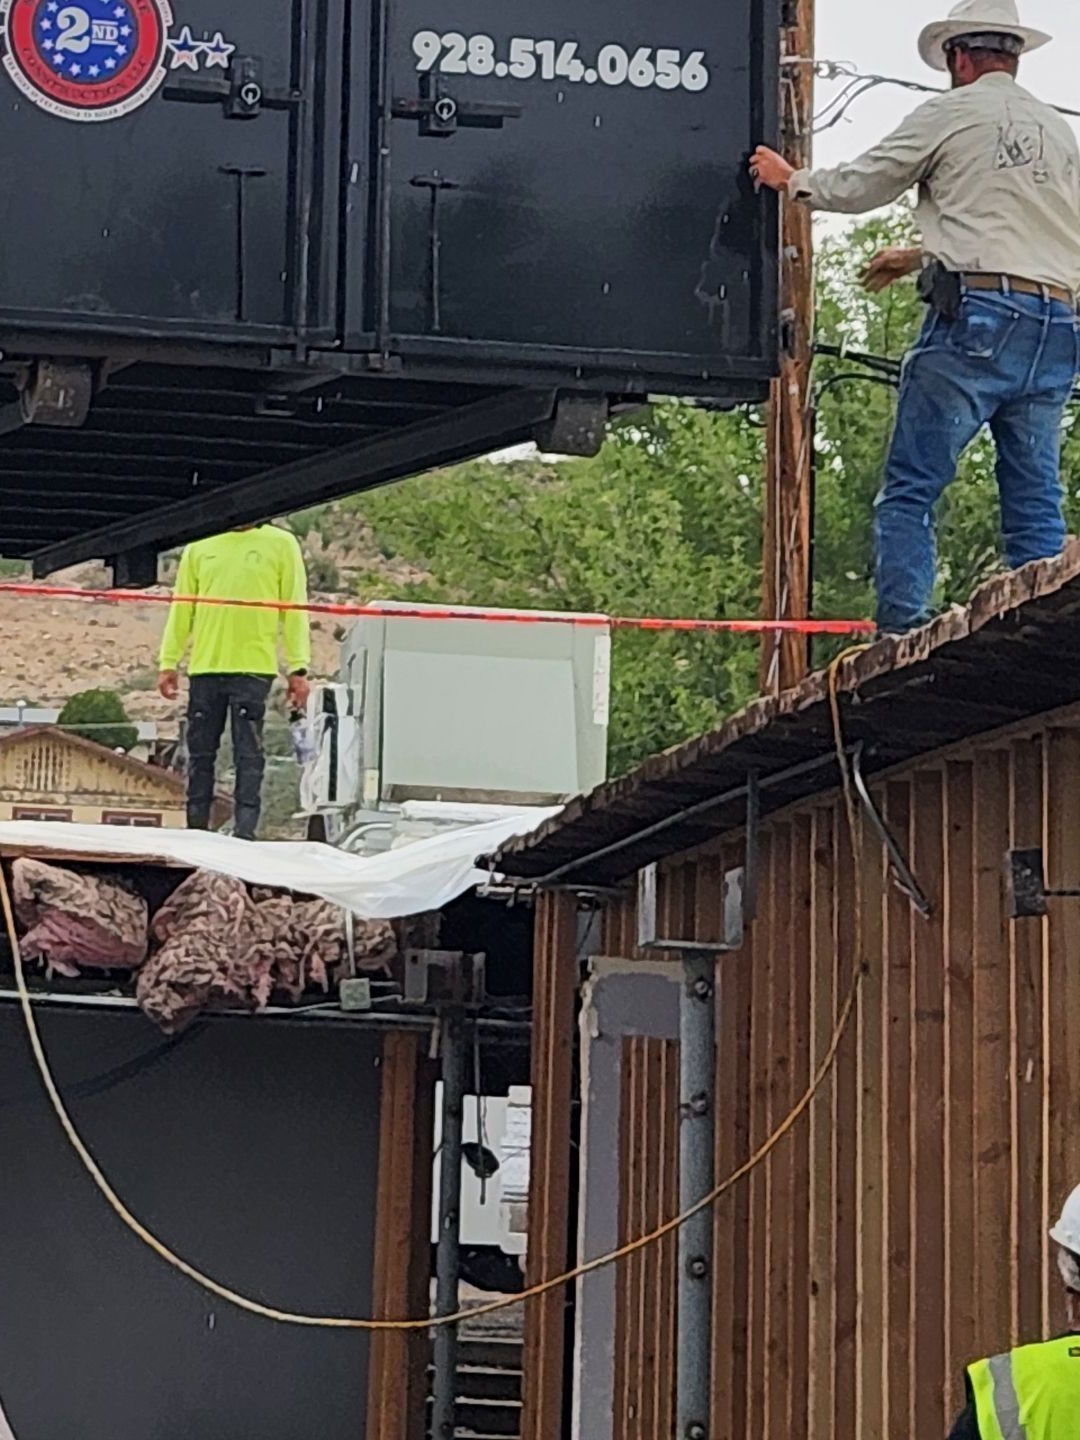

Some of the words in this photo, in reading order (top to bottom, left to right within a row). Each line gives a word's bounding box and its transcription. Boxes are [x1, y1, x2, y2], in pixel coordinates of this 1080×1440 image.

[55, 6, 118, 53] 2ND
[22, 48, 126, 100] CONSTRUCTION
[412, 30, 708, 91] 928.514.0656
